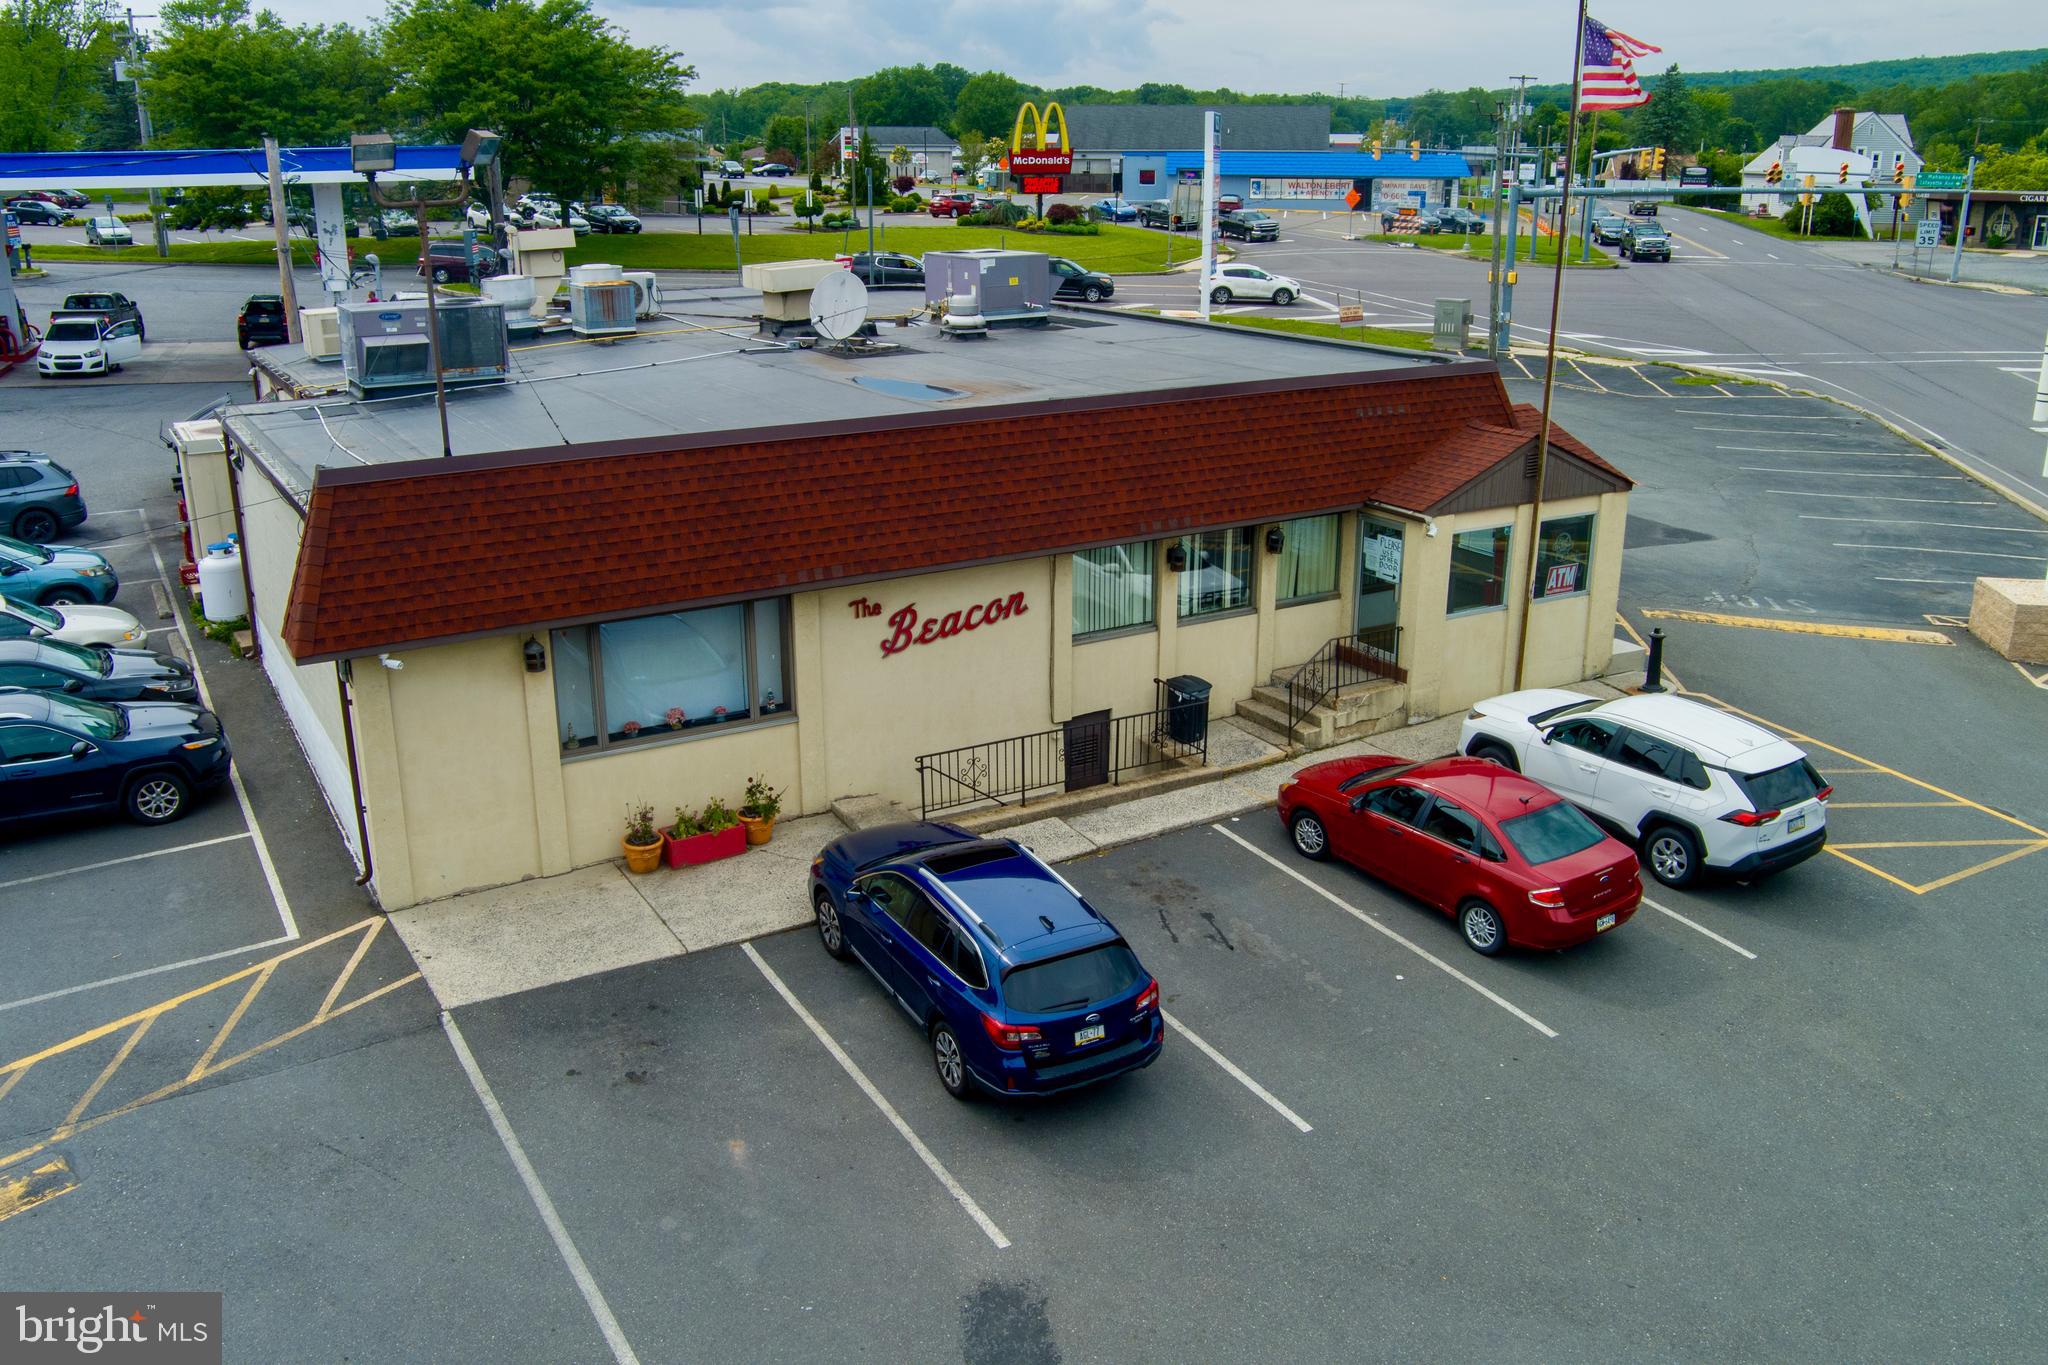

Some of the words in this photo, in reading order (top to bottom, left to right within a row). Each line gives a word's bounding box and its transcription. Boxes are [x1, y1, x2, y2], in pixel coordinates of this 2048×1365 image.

[1013, 157, 1070, 165] McDonald's
[2020, 194, 2045, 202] CIGAR
[1919, 236, 1935, 245] 35
[1380, 536, 1401, 552] PLEASE
[1380, 555, 1398, 566] OTHER
[1380, 561, 1398, 572] DOOR
[1547, 565, 1576, 589] ATM
[848, 597, 882, 619] The
[880, 591, 1029, 659] Beacon
